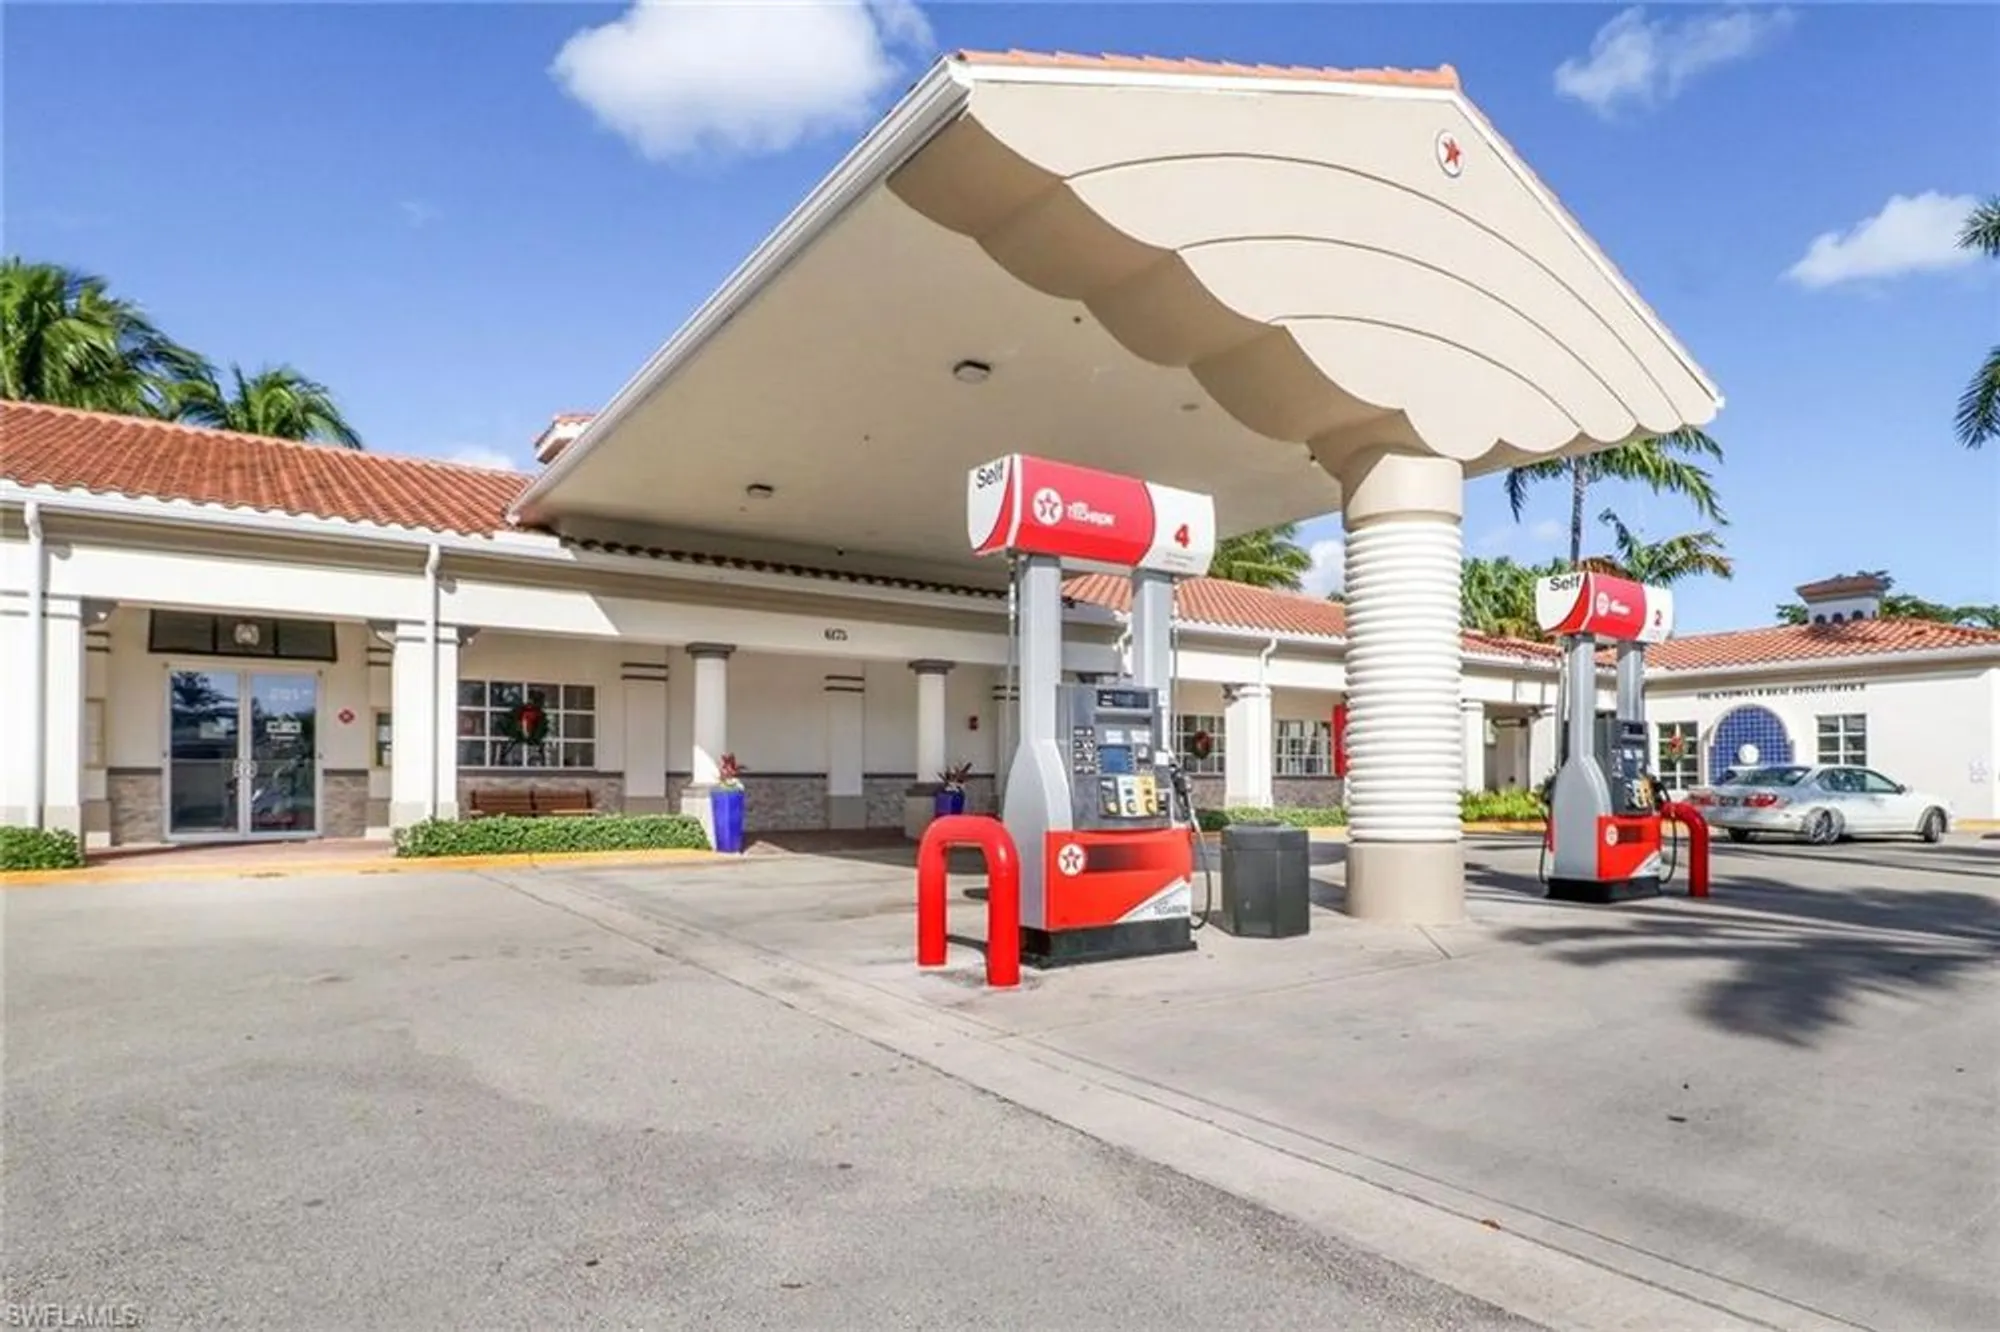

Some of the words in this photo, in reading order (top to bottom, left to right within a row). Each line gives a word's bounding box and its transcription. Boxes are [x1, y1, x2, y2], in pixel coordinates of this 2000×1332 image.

[976, 462, 1004, 489] Self
[1174, 523, 1191, 549] 4
[1549, 575, 1580, 591] Self
[1654, 609, 1663, 627] 2
